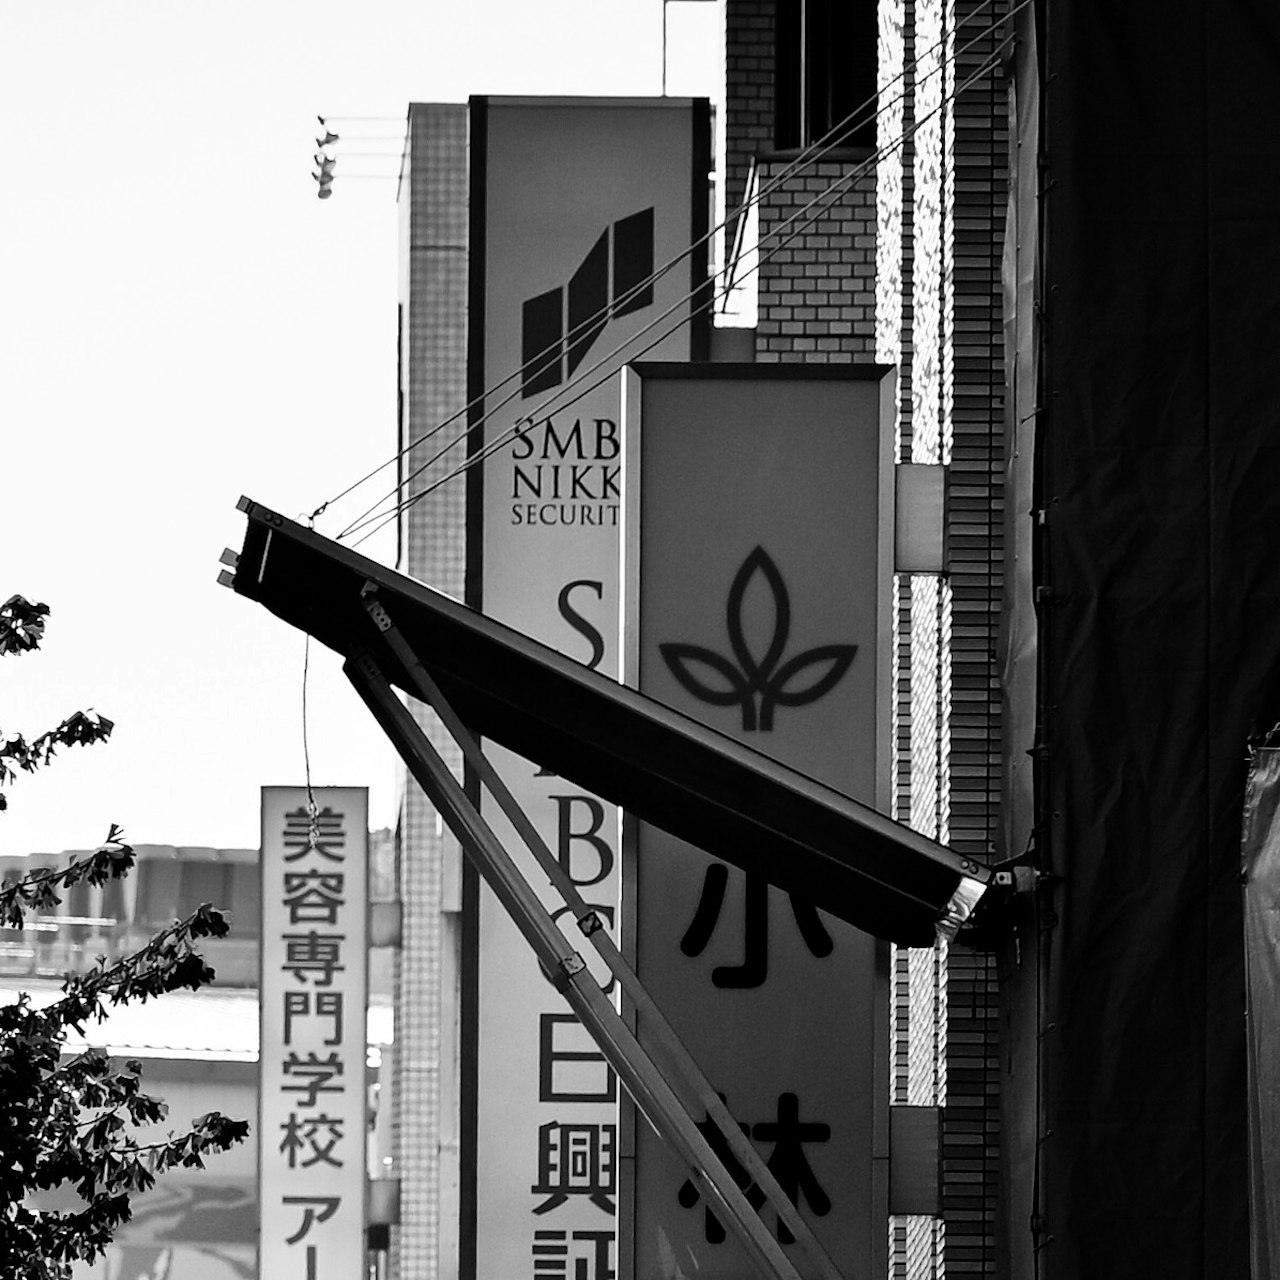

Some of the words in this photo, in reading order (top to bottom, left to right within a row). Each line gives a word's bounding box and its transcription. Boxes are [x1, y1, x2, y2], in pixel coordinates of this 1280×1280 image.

[512, 464, 620, 499] NIKK
[280, 808, 345, 1171] 美容専門学校
